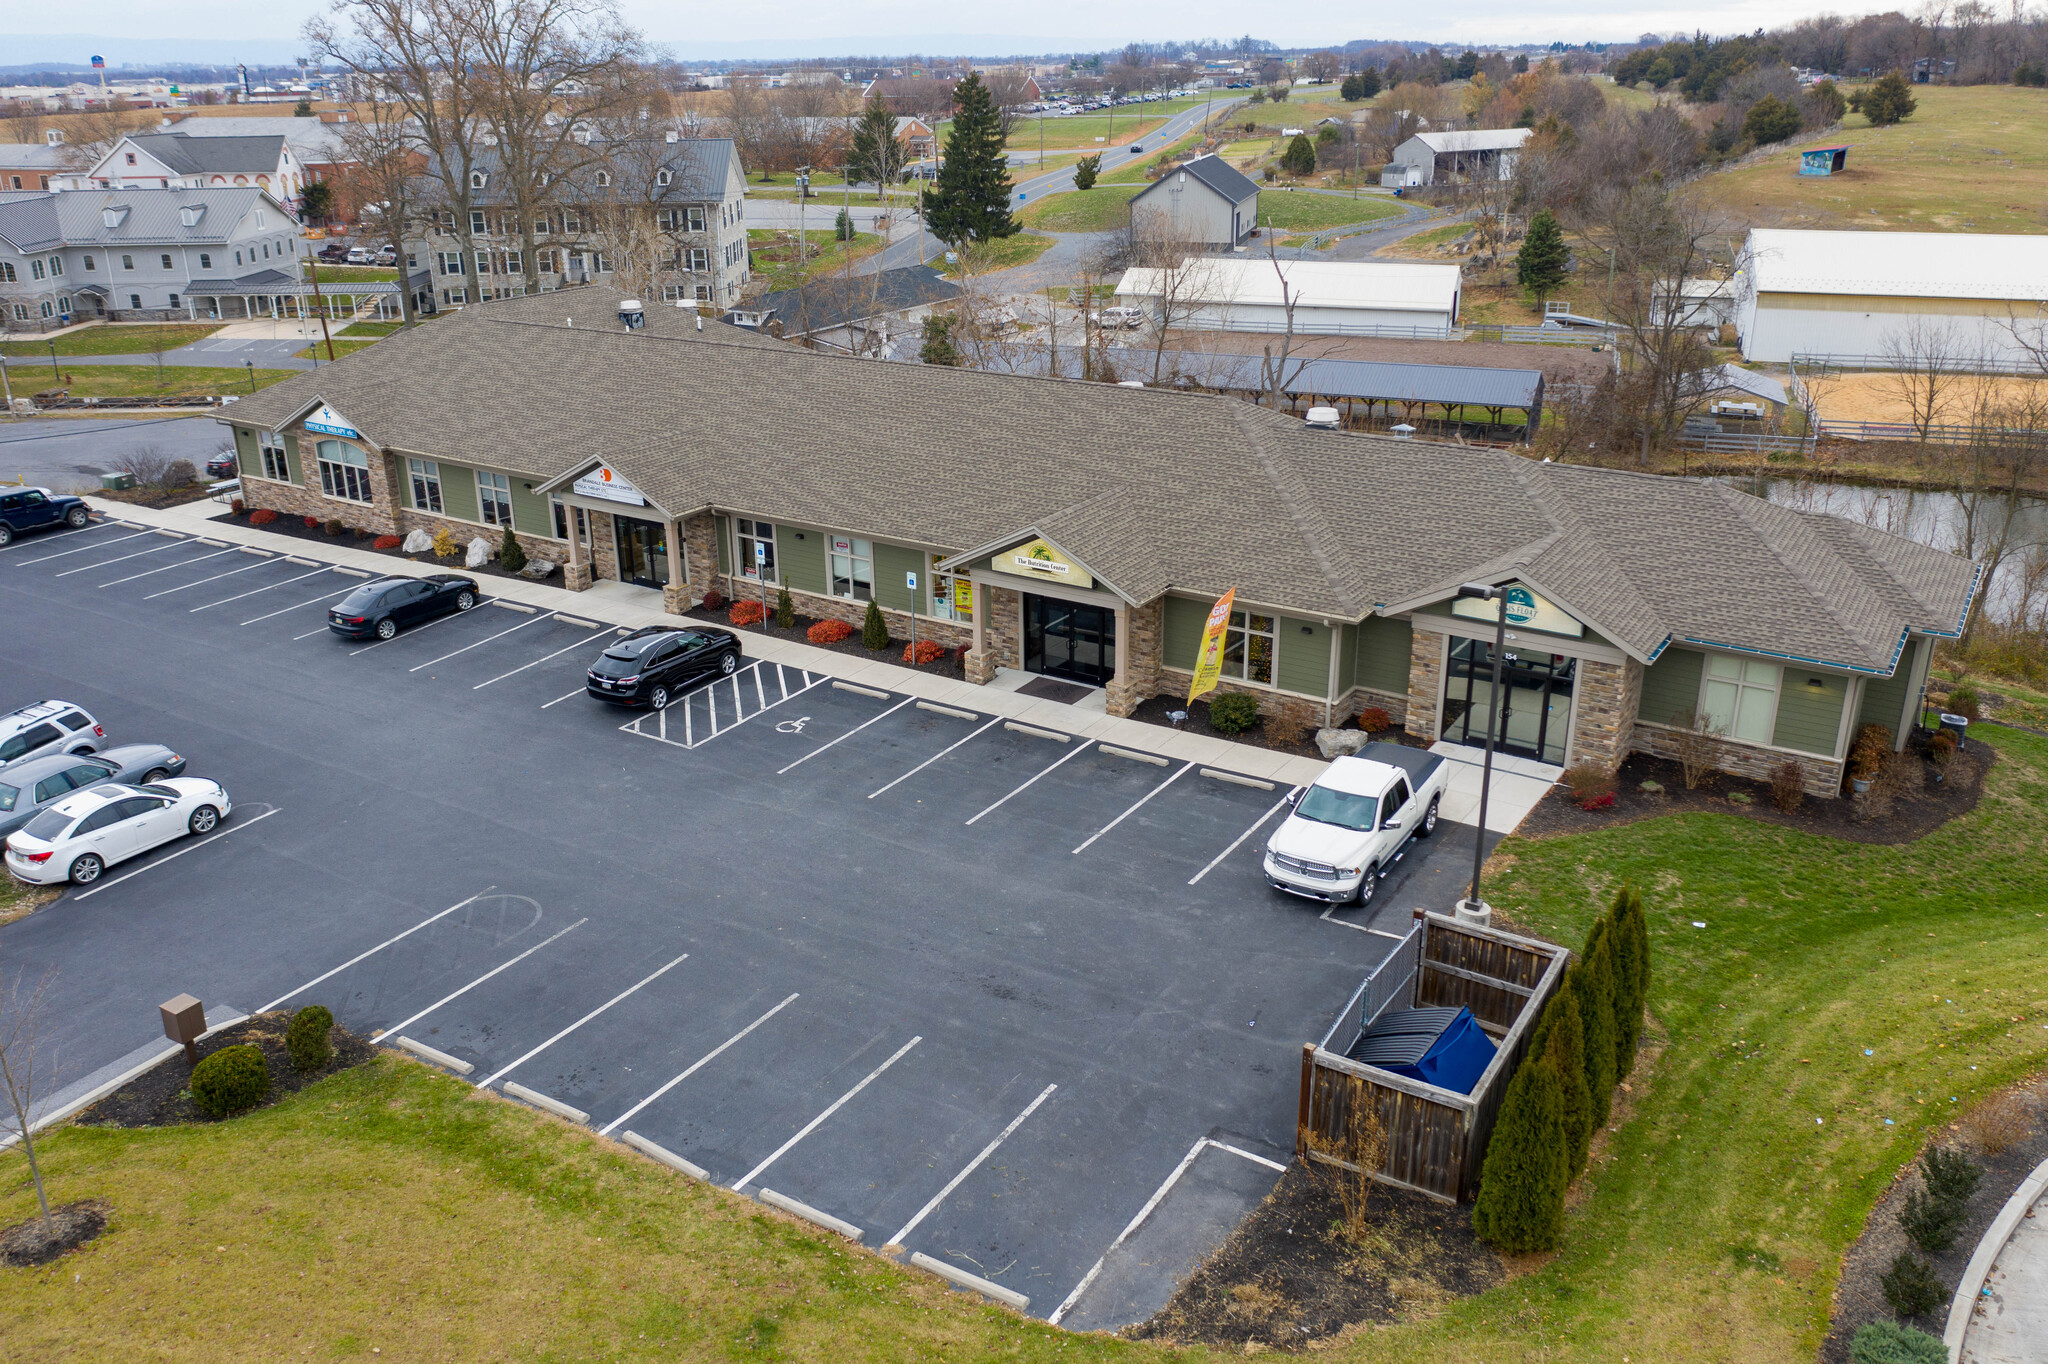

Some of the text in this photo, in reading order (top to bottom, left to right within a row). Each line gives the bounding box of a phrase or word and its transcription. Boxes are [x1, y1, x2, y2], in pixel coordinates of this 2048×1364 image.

[305, 422, 326, 431] PHYSICAL
[326, 426, 346, 434] THERAPY
[1017, 557, 1066, 572] The Nutrition Center
[1516, 606, 1538, 618] FLOAT
[1505, 652, 1517, 661] 154
